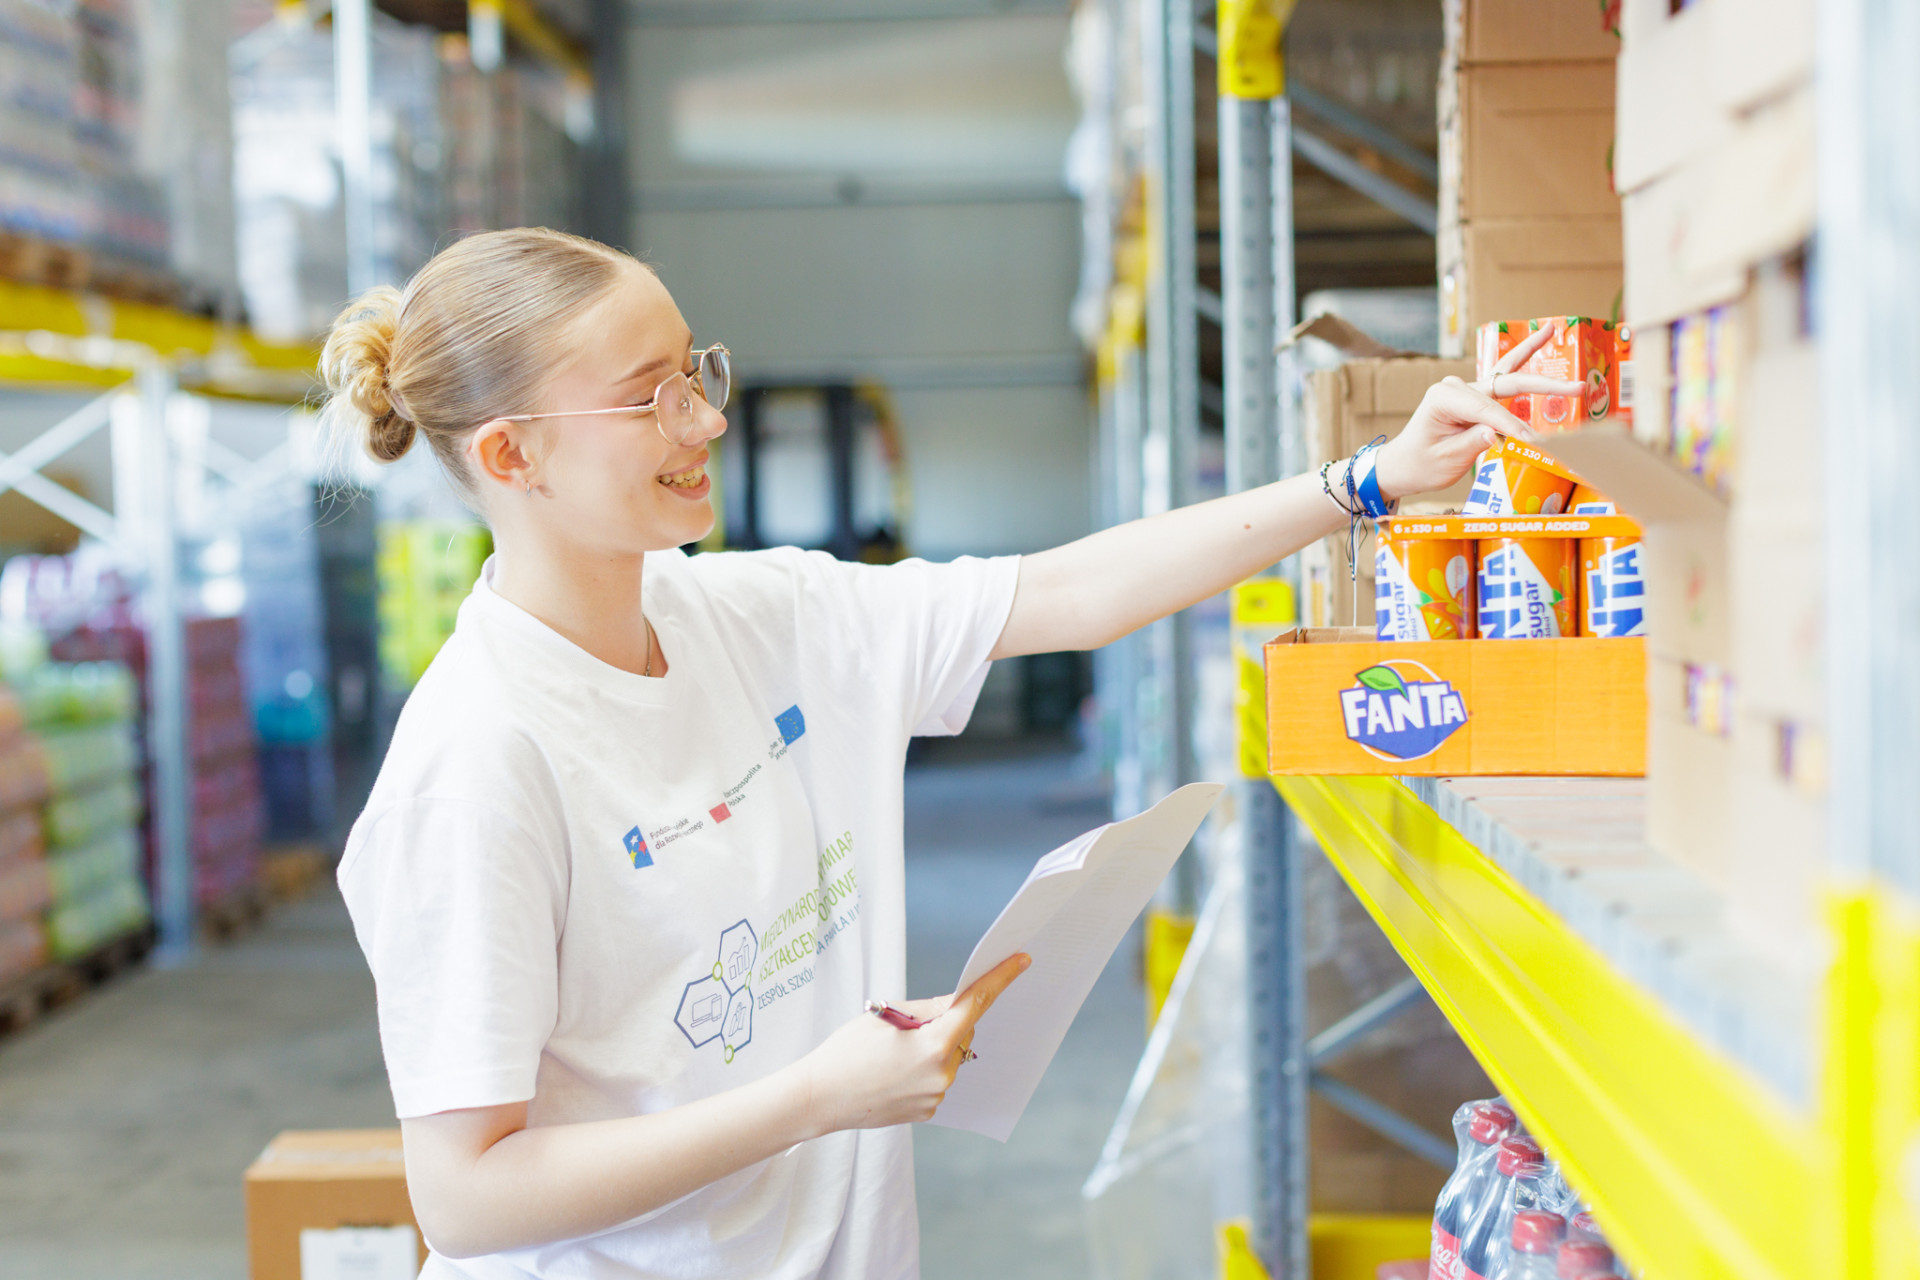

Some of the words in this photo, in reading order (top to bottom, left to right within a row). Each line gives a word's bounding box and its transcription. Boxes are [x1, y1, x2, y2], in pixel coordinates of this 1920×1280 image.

[1507, 442, 1515, 451] 6
[1522, 448, 1541, 461] 330
[1541, 456, 1556, 466] ml
[1393, 524, 1403, 534] 6
[1412, 524, 1432, 534] 330
[1433, 524, 1448, 533] ml
[1463, 522, 1498, 533] ZERO
[1500, 521, 1544, 532] SUGAR
[1545, 521, 1590, 531] ADDED
[1394, 581, 1412, 640] sugar
[1479, 549, 1527, 638] NTA
[1524, 580, 1545, 638] sugar
[1591, 548, 1645, 638] NTA
[1341, 684, 1466, 738] FANTA
